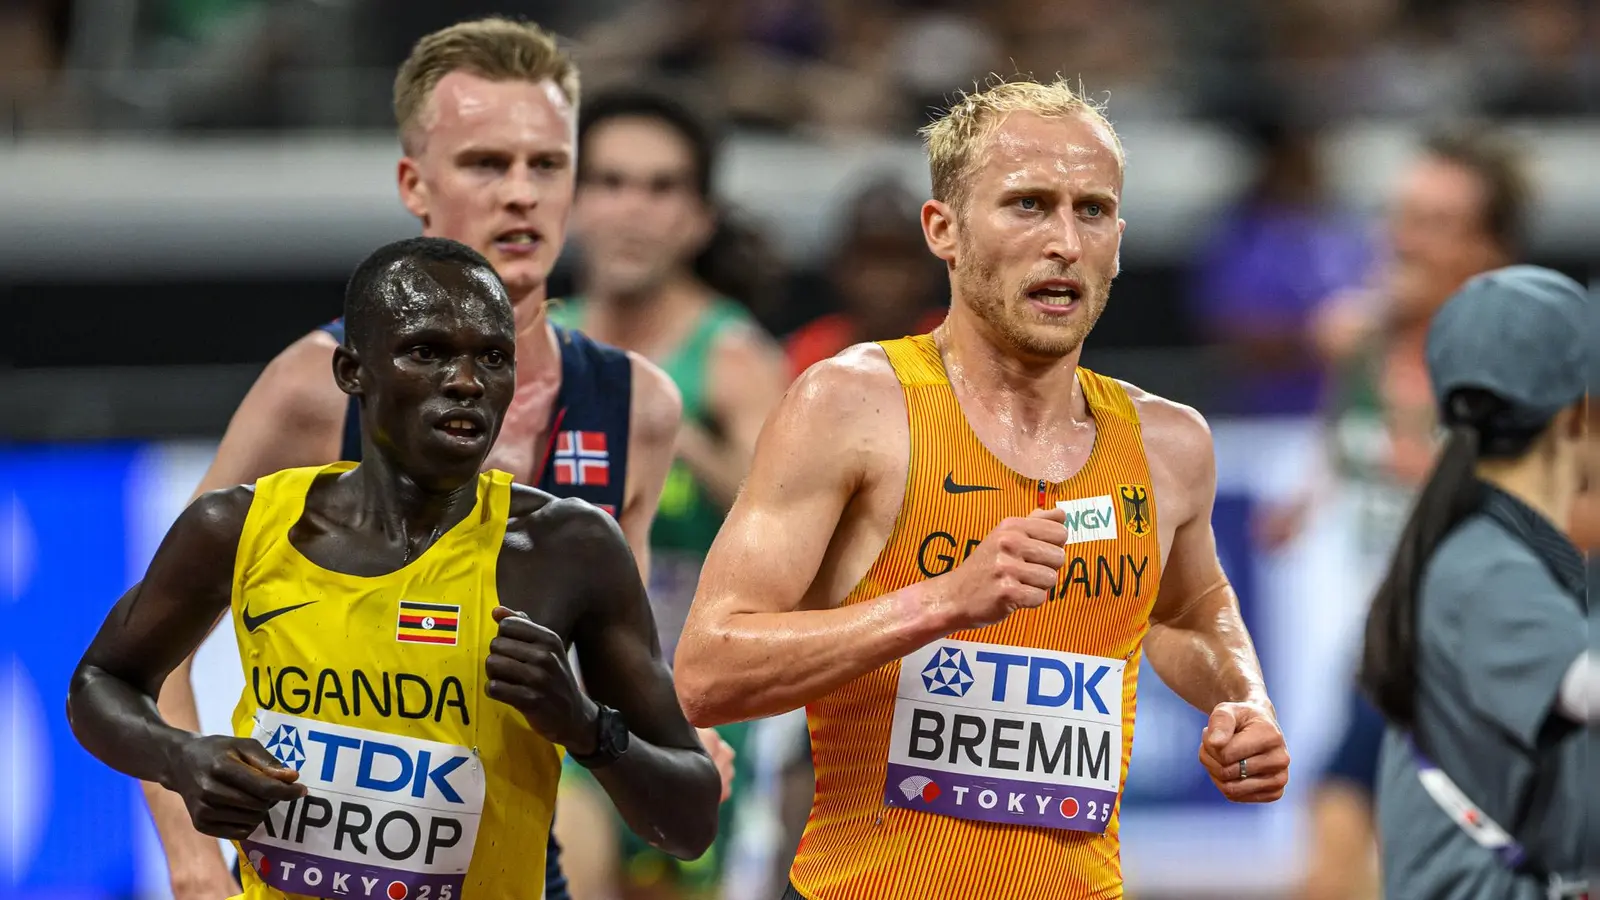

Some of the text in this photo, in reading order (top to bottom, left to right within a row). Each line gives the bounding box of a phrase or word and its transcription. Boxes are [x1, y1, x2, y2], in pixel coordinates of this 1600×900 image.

[917, 531, 1149, 602] GANY
[252, 666, 470, 726] UGANDA
[976, 650, 1111, 715] TDK
[307, 729, 470, 804] TDK
[907, 708, 1111, 781] BREMM
[952, 785, 1110, 823] TOKYO 25
[279, 861, 452, 900] TOKYO 25
